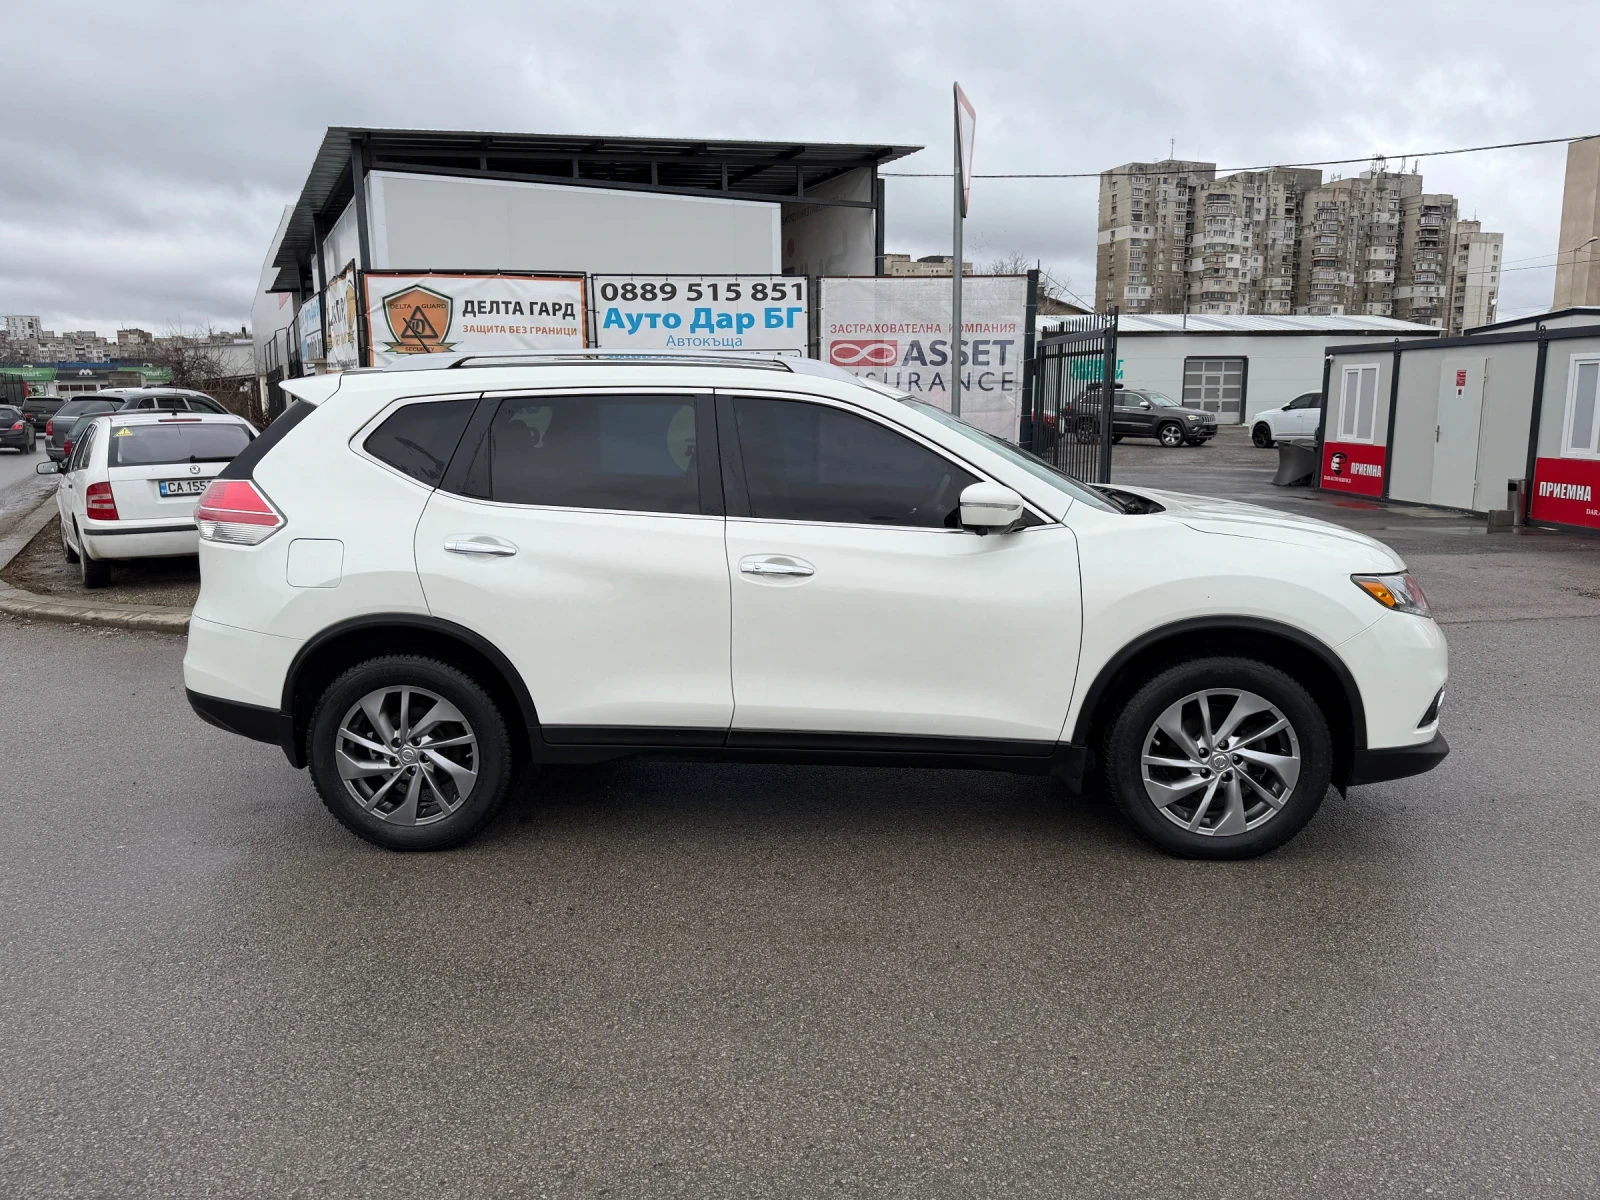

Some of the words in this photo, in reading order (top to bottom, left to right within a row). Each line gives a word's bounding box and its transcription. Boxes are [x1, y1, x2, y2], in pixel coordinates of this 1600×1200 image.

[600, 282, 677, 302] 0889
[686, 282, 742, 302] 515
[750, 282, 803, 302] 851
[462, 300, 525, 318] ДЕЛТА
[529, 302, 576, 321] ГАРД
[602, 307, 682, 335] Ауто
[689, 307, 755, 335] Дар
[764, 307, 803, 329] БГ
[830, 323, 942, 334] ЗАСТРАХОВАТЕЛНА
[462, 324, 506, 335] ЗАЩИТА
[508, 325, 528, 335] БЕЗ
[529, 326, 578, 338] ГРАНИЦИ
[666, 335, 743, 348] Автокъща
[1350, 462, 1382, 478] ПРИЕМНА
[168, 481, 184, 493] CA
[1539, 481, 1592, 502] ПРИЕМНА
